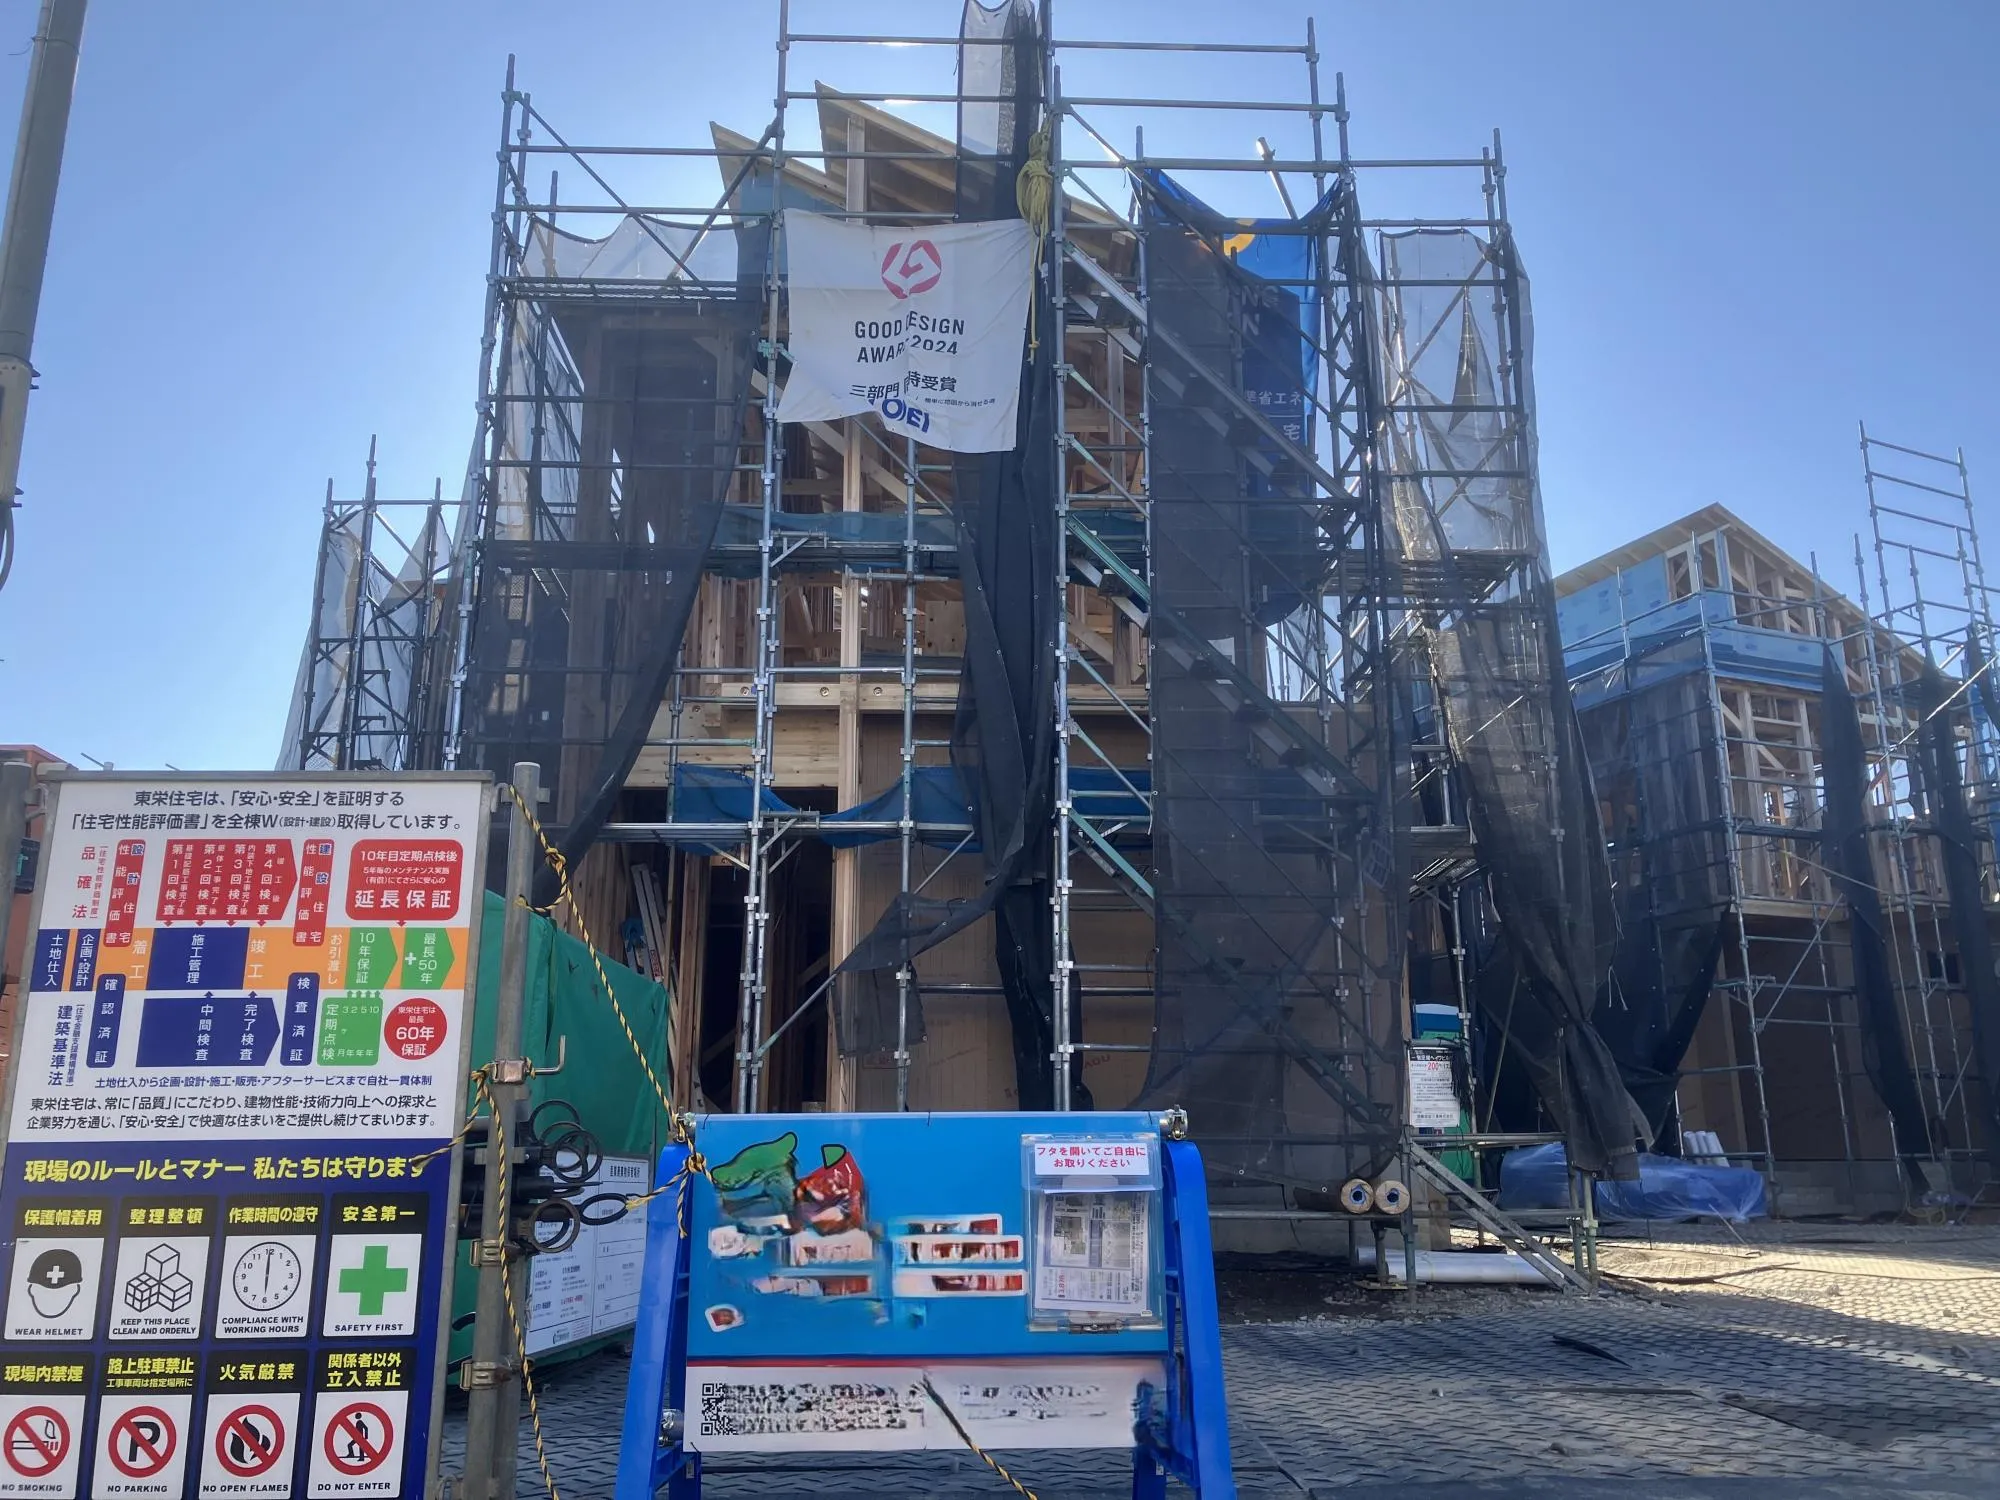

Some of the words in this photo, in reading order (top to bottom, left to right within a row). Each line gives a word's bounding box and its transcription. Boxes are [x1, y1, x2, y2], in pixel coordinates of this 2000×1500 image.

[855, 319, 902, 339] GOOD
[906, 310, 965, 335] ESIGN
[857, 337, 909, 363] AWAR
[911, 334, 958, 355] 2024
[868, 398, 930, 433] OEI
[134, 790, 404, 807] 東栄住宅は、「安心・安全」を証明する
[361, 850, 458, 862] 10年目定期点検後
[72, 847, 95, 919] 品確法
[354, 889, 452, 909] 延長保証
[45, 934, 63, 986] 土地仕入
[128, 939, 148, 980] 着工
[186, 933, 206, 985] 施工管理
[248, 939, 267, 979] 竣工
[327, 934, 342, 985] お引渡し
[356, 931, 376, 984] 10年保証
[417, 932, 438, 985] 最長50年
[289, 976, 312, 1062] 検査済証
[398, 1006, 437, 1014] 東栄住宅は
[94, 978, 118, 1064] 確認済証
[194, 1004, 214, 1062] 中間検査
[239, 1003, 259, 1062] 完了検査
[321, 1004, 339, 1061] 定期点検
[396, 1026, 435, 1042] 60年
[48, 1004, 74, 1087] 建築基準法
[401, 1043, 427, 1057] 保証
[1036, 1145, 1147, 1157] フタを開いてご自由に
[24, 1158, 245, 1183] 現場のルールとマナー
[1053, 1158, 1131, 1169] お取りください
[24, 1209, 103, 1226] 保護帽着用
[129, 1207, 204, 1225] 整理整頓
[228, 1205, 319, 1224] 作業時間の遵守
[342, 1204, 416, 1222] 安全第一
[120, 1317, 142, 1326] KEEP
[144, 1317, 163, 1325] THIS
[164, 1317, 190, 1326] PLACE
[222, 1316, 279, 1325] COMPLIANCE
[280, 1315, 304, 1324] WITH
[334, 1323, 372, 1332] SAFETY
[375, 1323, 404, 1332] FIRST
[15, 1327, 42, 1336] WEAR
[44, 1327, 83, 1336] HELMET
[112, 1327, 139, 1336] CLEAN
[140, 1327, 158, 1335] AND
[159, 1326, 197, 1335] ORDERLY
[224, 1326, 267, 1335] WORKING
[268, 1325, 300, 1334] HOURS
[107, 1357, 195, 1375] 路上駐車禁止
[328, 1352, 402, 1369] 関係者以外
[4, 1365, 84, 1383] 現場内禁煙
[219, 1363, 295, 1381] 火気厳禁
[326, 1370, 401, 1388] 立入禁止
[1, 1484, 15, 1492] NO
[17, 1484, 63, 1492] SMOKING
[107, 1485, 122, 1493] NO
[124, 1485, 168, 1493] PARKING
[202, 1485, 217, 1493] NO
[220, 1484, 247, 1493] OPEN
[249, 1484, 289, 1493] FLAMES
[317, 1482, 332, 1491] DO
[334, 1482, 355, 1490] NOT
[358, 1482, 391, 1490] ENTER
